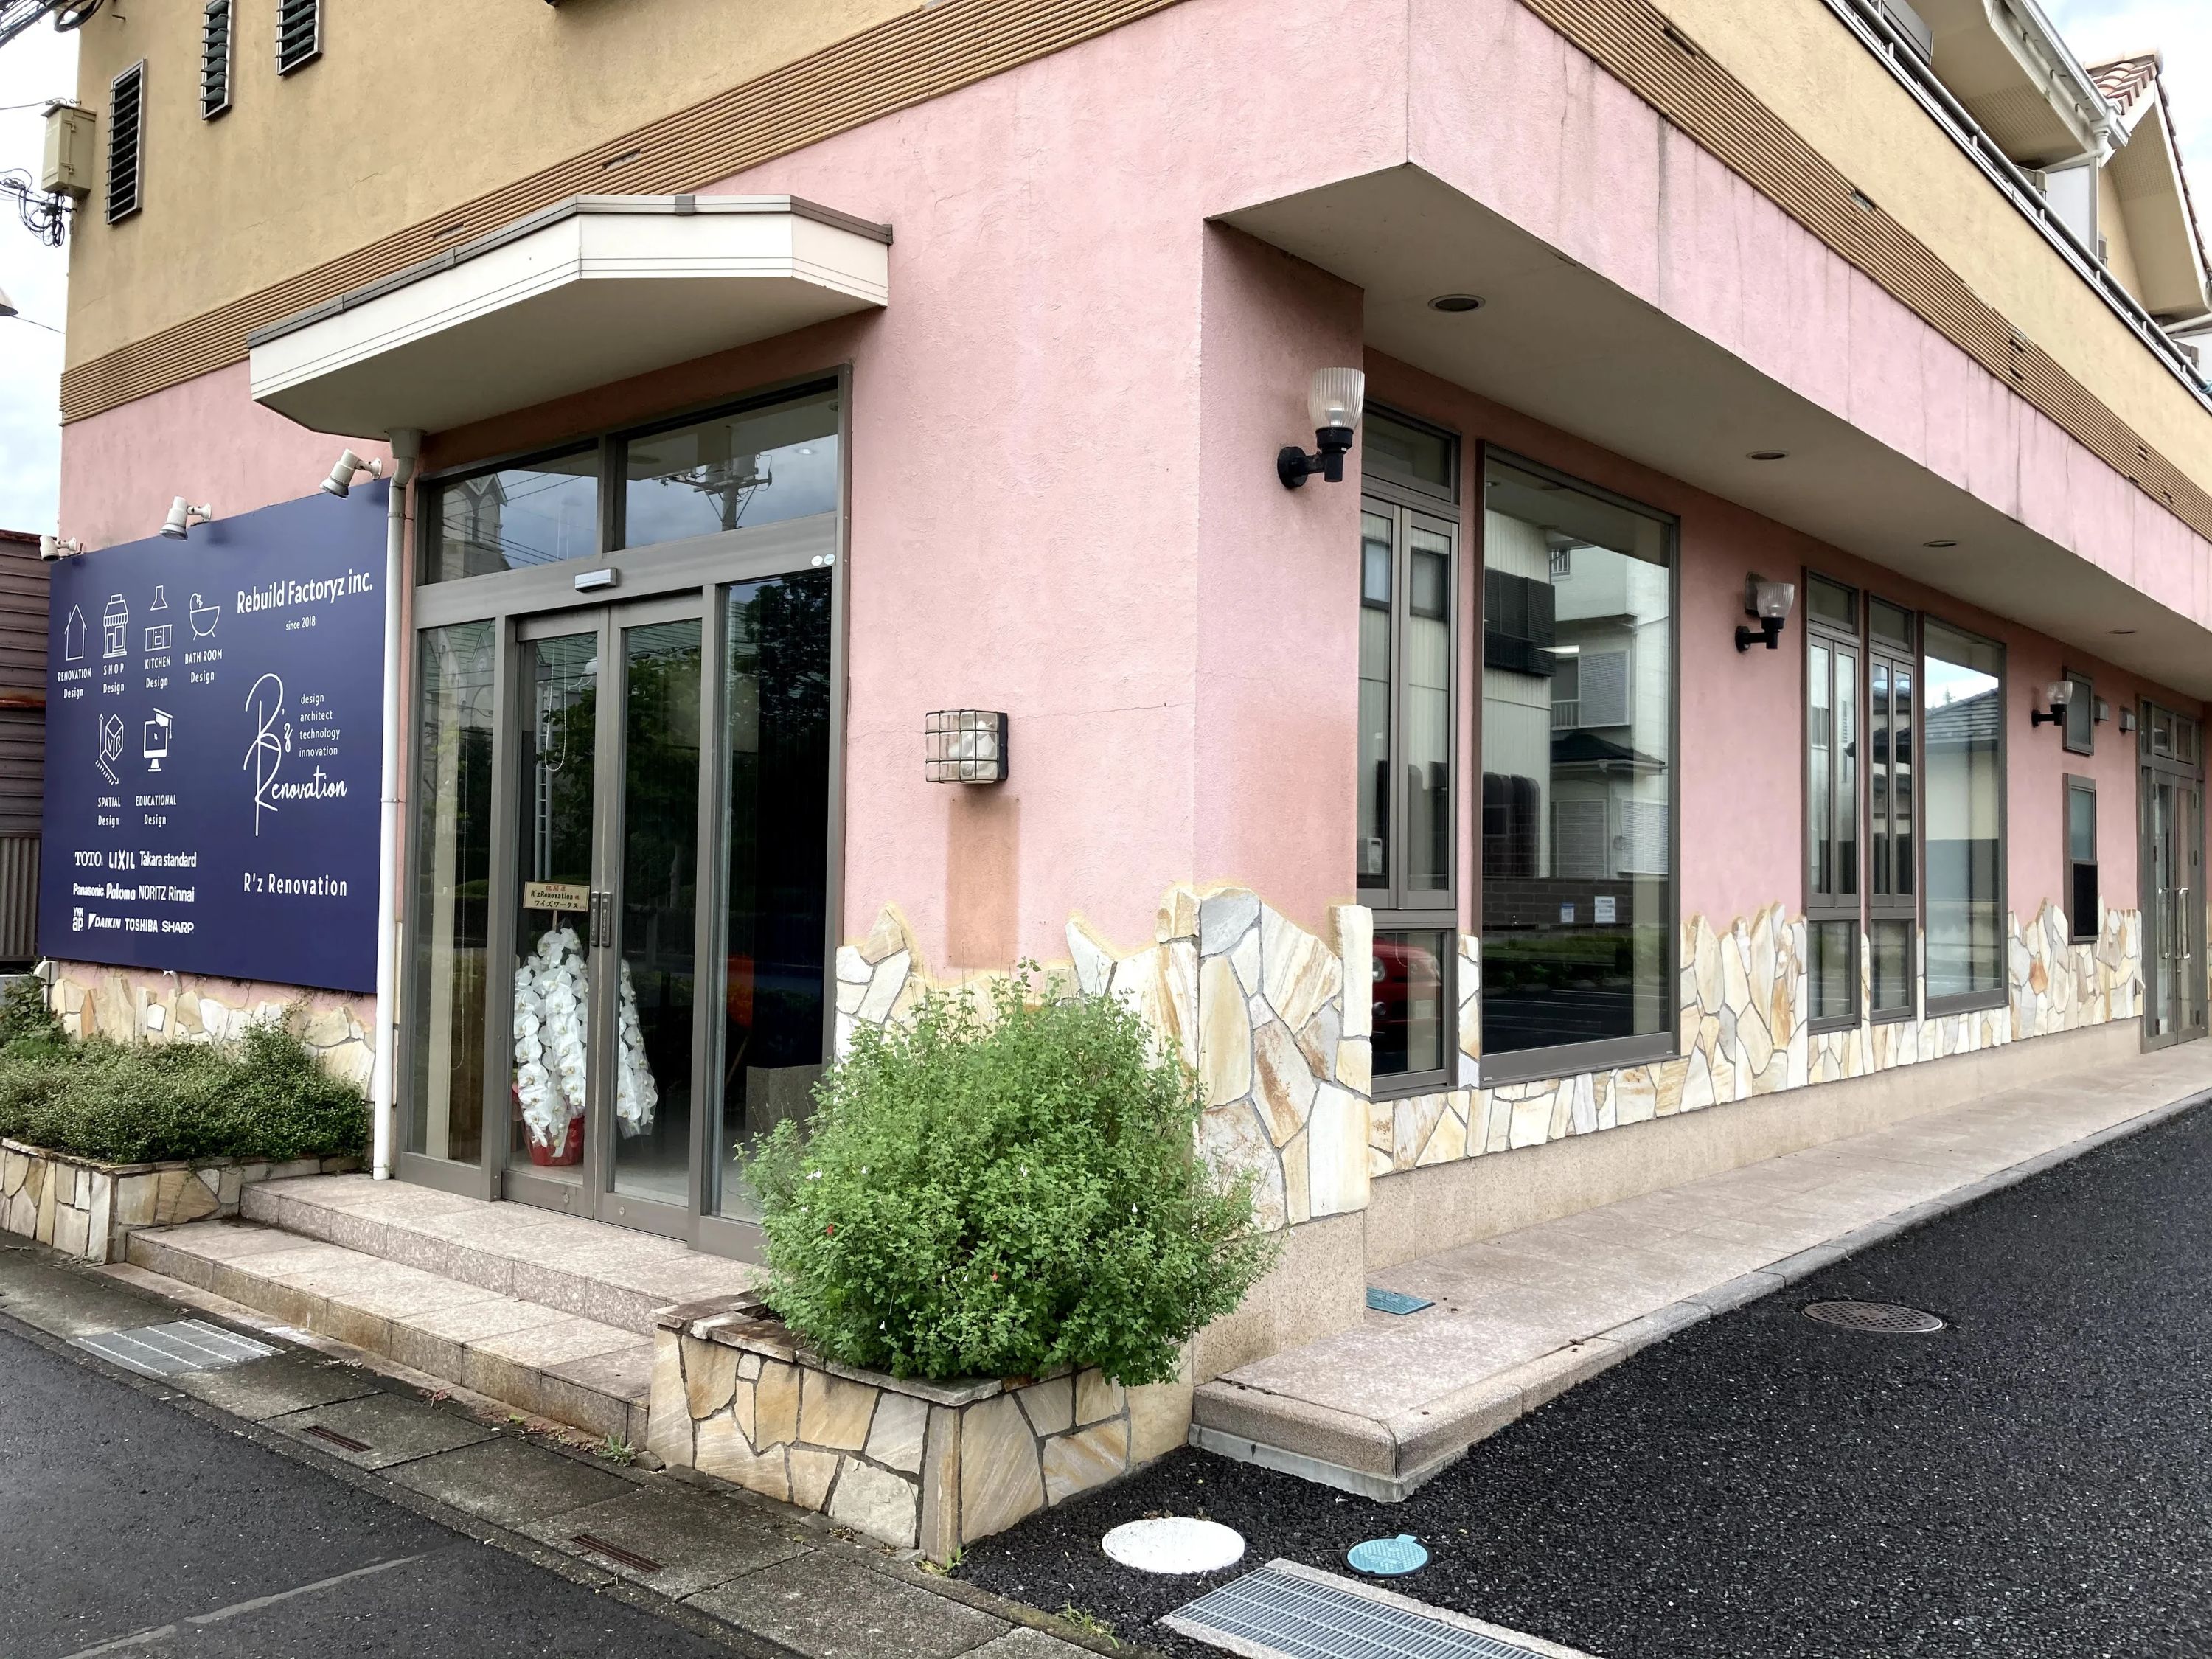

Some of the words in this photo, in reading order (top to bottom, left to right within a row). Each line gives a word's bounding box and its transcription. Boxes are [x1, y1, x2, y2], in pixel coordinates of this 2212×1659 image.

[237, 580, 285, 614] Rebuild
[288, 577, 346, 604] Factoryz
[348, 568, 372, 594] inc.
[285, 620, 300, 631] since
[302, 615, 316, 628] 2018
[145, 656, 171, 669] KITCHEN
[184, 651, 201, 664] BATH
[203, 649, 223, 662] ROOM
[58, 667, 91, 682] RENOVATION
[190, 671, 215, 684] Design
[103, 682, 125, 695] Design
[145, 677, 168, 689] Design
[63, 688, 83, 700] Design
[300, 694, 324, 706] design
[299, 710, 333, 722] architect
[299, 727, 340, 740] technology
[299, 745, 338, 757] innovation
[97, 796, 121, 807] SPATIAL
[135, 795, 176, 807] EDUCATIONAL
[97, 815, 119, 828] Design
[144, 814, 167, 828] Design
[74, 851, 102, 866] TOTO
[108, 849, 136, 871] LIXIL
[139, 850, 162, 866] Takara
[163, 851, 197, 867] standard
[243, 872, 263, 892] R'z
[268, 873, 347, 897] Renovation
[73, 883, 105, 897] Panasonic
[105, 882, 136, 900] Paloma
[138, 884, 167, 900] NORITZ
[168, 886, 195, 902] Rinnai
[534, 900, 579, 909] ワイズワークス
[72, 917, 83, 931] ap
[94, 917, 122, 928] DAIKIN
[125, 917, 158, 933] TOSHIBA
[161, 920, 195, 934] SHARP
